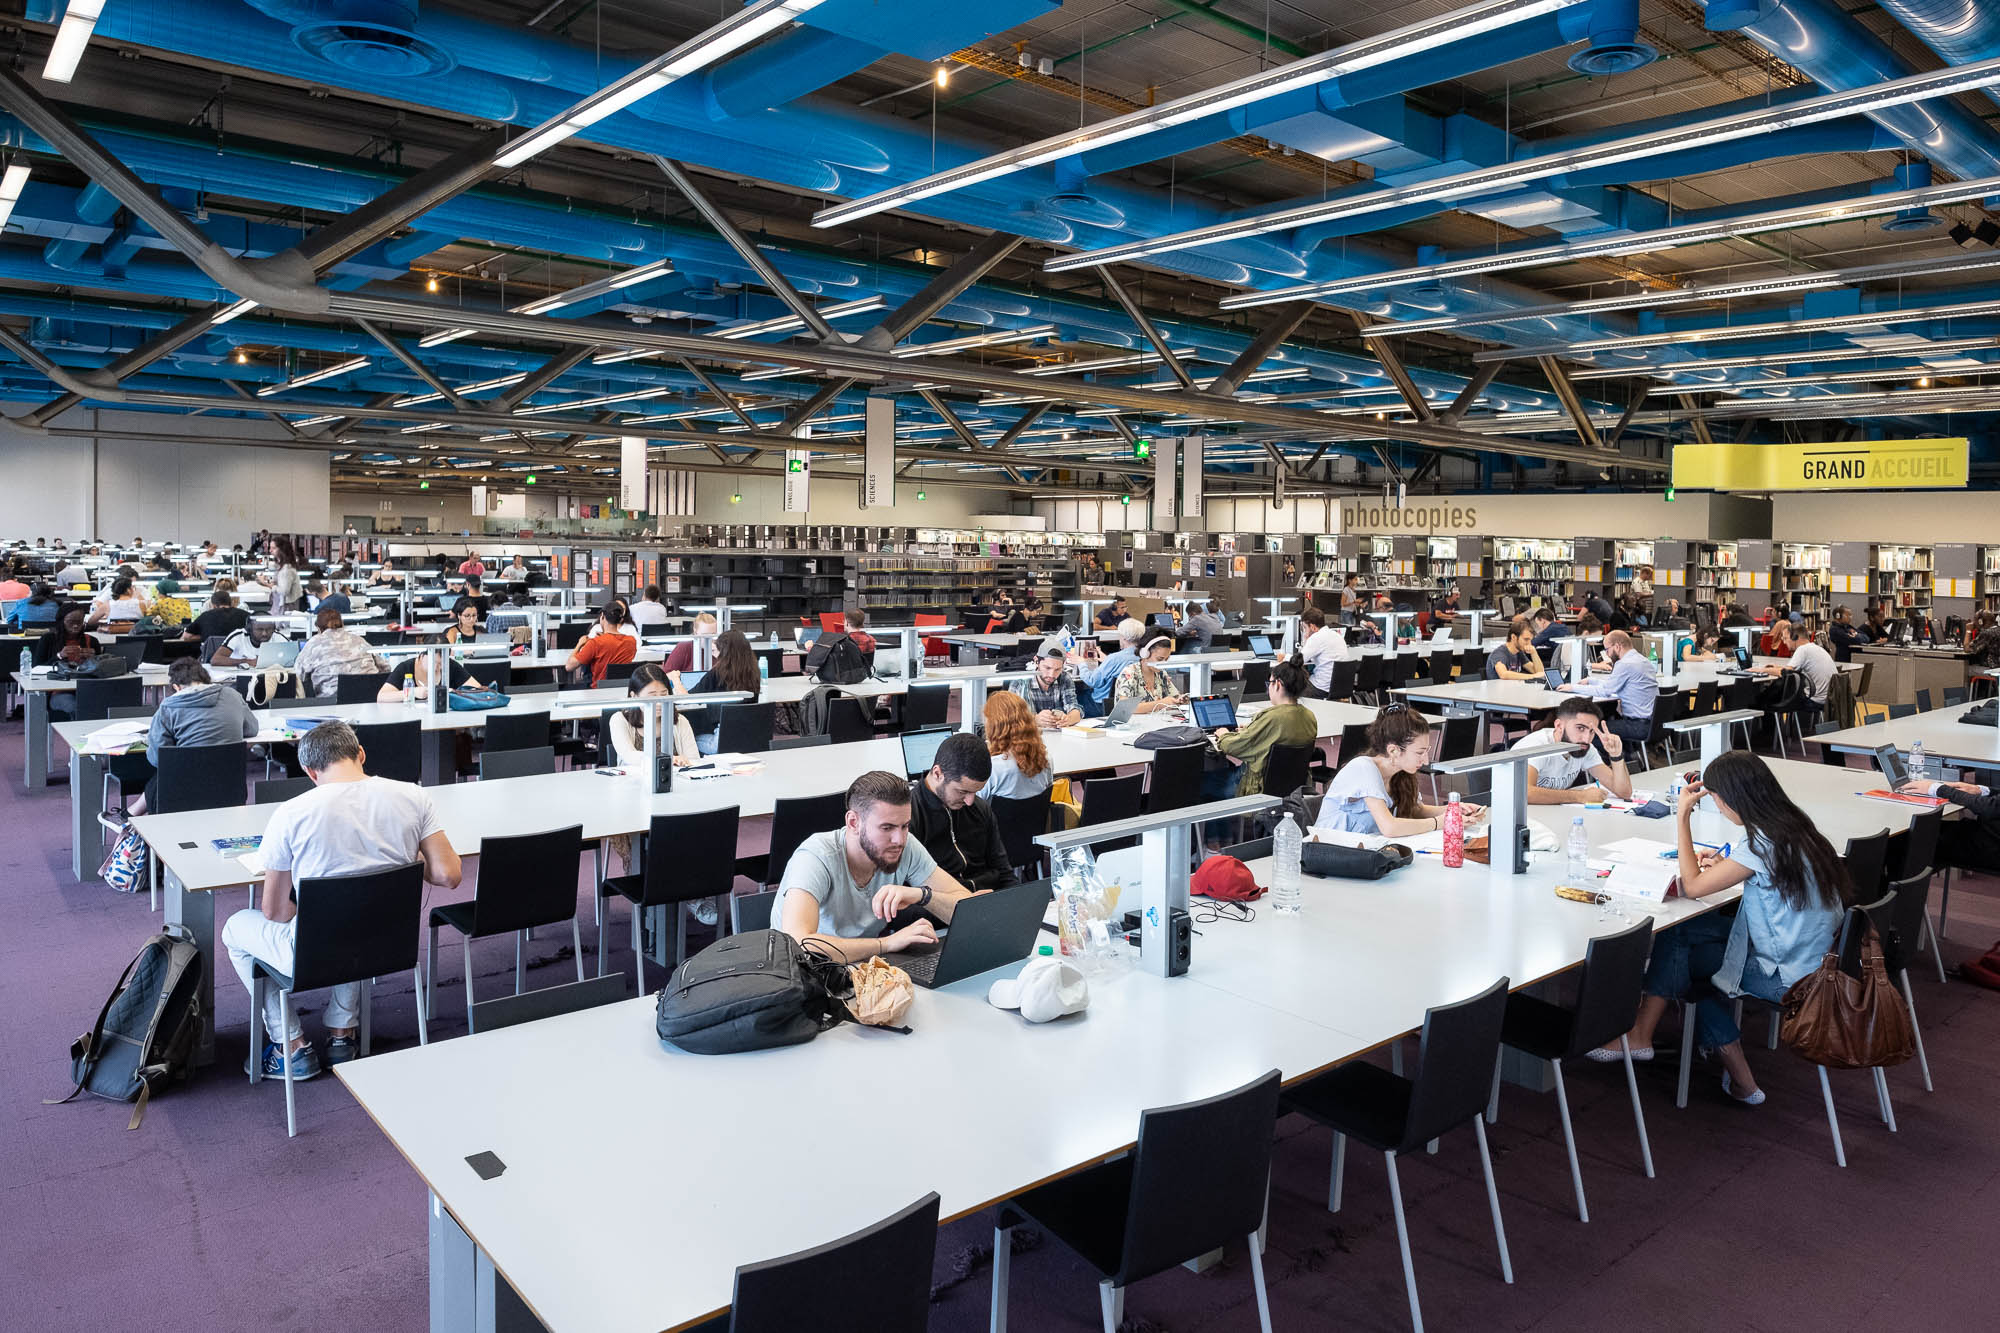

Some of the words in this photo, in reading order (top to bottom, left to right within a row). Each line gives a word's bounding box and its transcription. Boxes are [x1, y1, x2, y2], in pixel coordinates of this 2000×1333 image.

[1803, 460, 1865, 480] GRAND
[1871, 457, 1954, 479] ACCUEIL
[1344, 500, 1477, 536] photocopies
